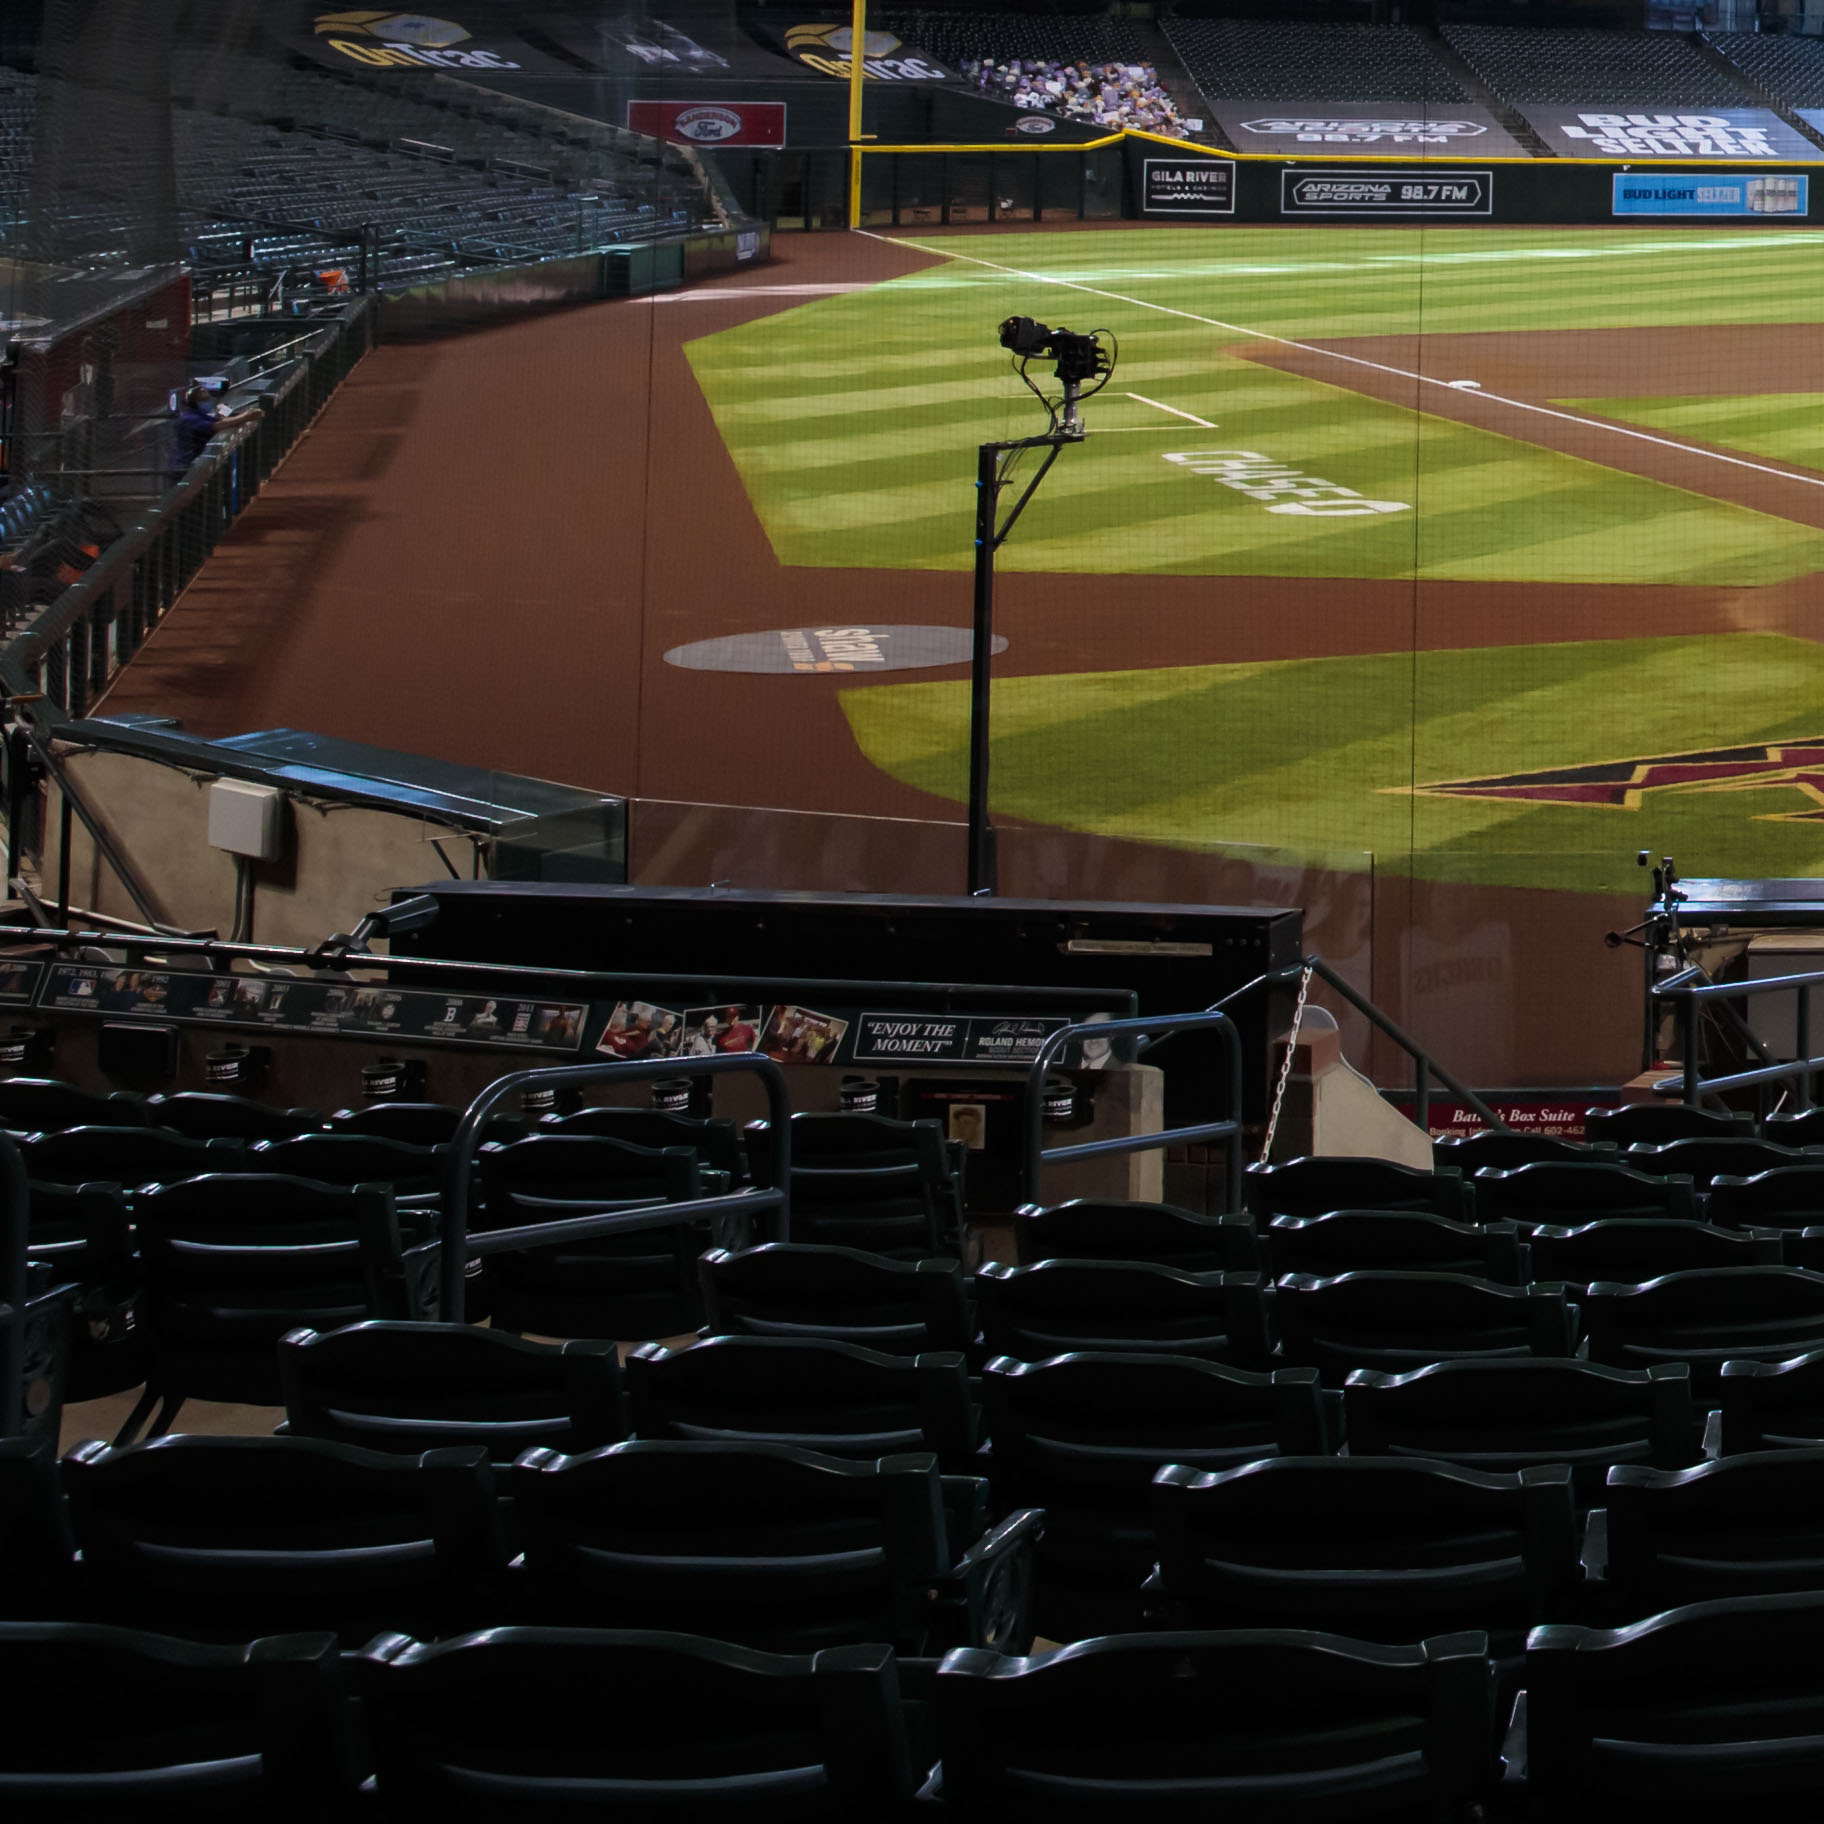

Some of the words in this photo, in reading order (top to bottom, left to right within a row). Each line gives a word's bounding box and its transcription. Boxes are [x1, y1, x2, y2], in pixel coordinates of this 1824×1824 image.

[328, 39, 521, 69] OnTrac
[1577, 114, 1731, 128] BUD
[1561, 126, 1770, 140] LIGHT
[1591, 139, 1780, 155] SELTZER
[1152, 171, 1182, 183] GILA
[1187, 171, 1227, 183] RIVER
[1301, 184, 1392, 192] ARIZONA
[1401, 185, 1438, 200] 98.7
[1441, 186, 1467, 200] FM
[1623, 189, 1653, 201] BUD
[1654, 189, 1696, 201] LIGHT
[1305, 192, 1386, 201] SPORTS
[1161, 450, 1364, 500] CHASE
[923, 1023, 956, 1038] THE
[978, 1036, 1014, 1047] ROLAND
[1510, 1109, 1536, 1122] Box
[1539, 1109, 1575, 1122] Suite
